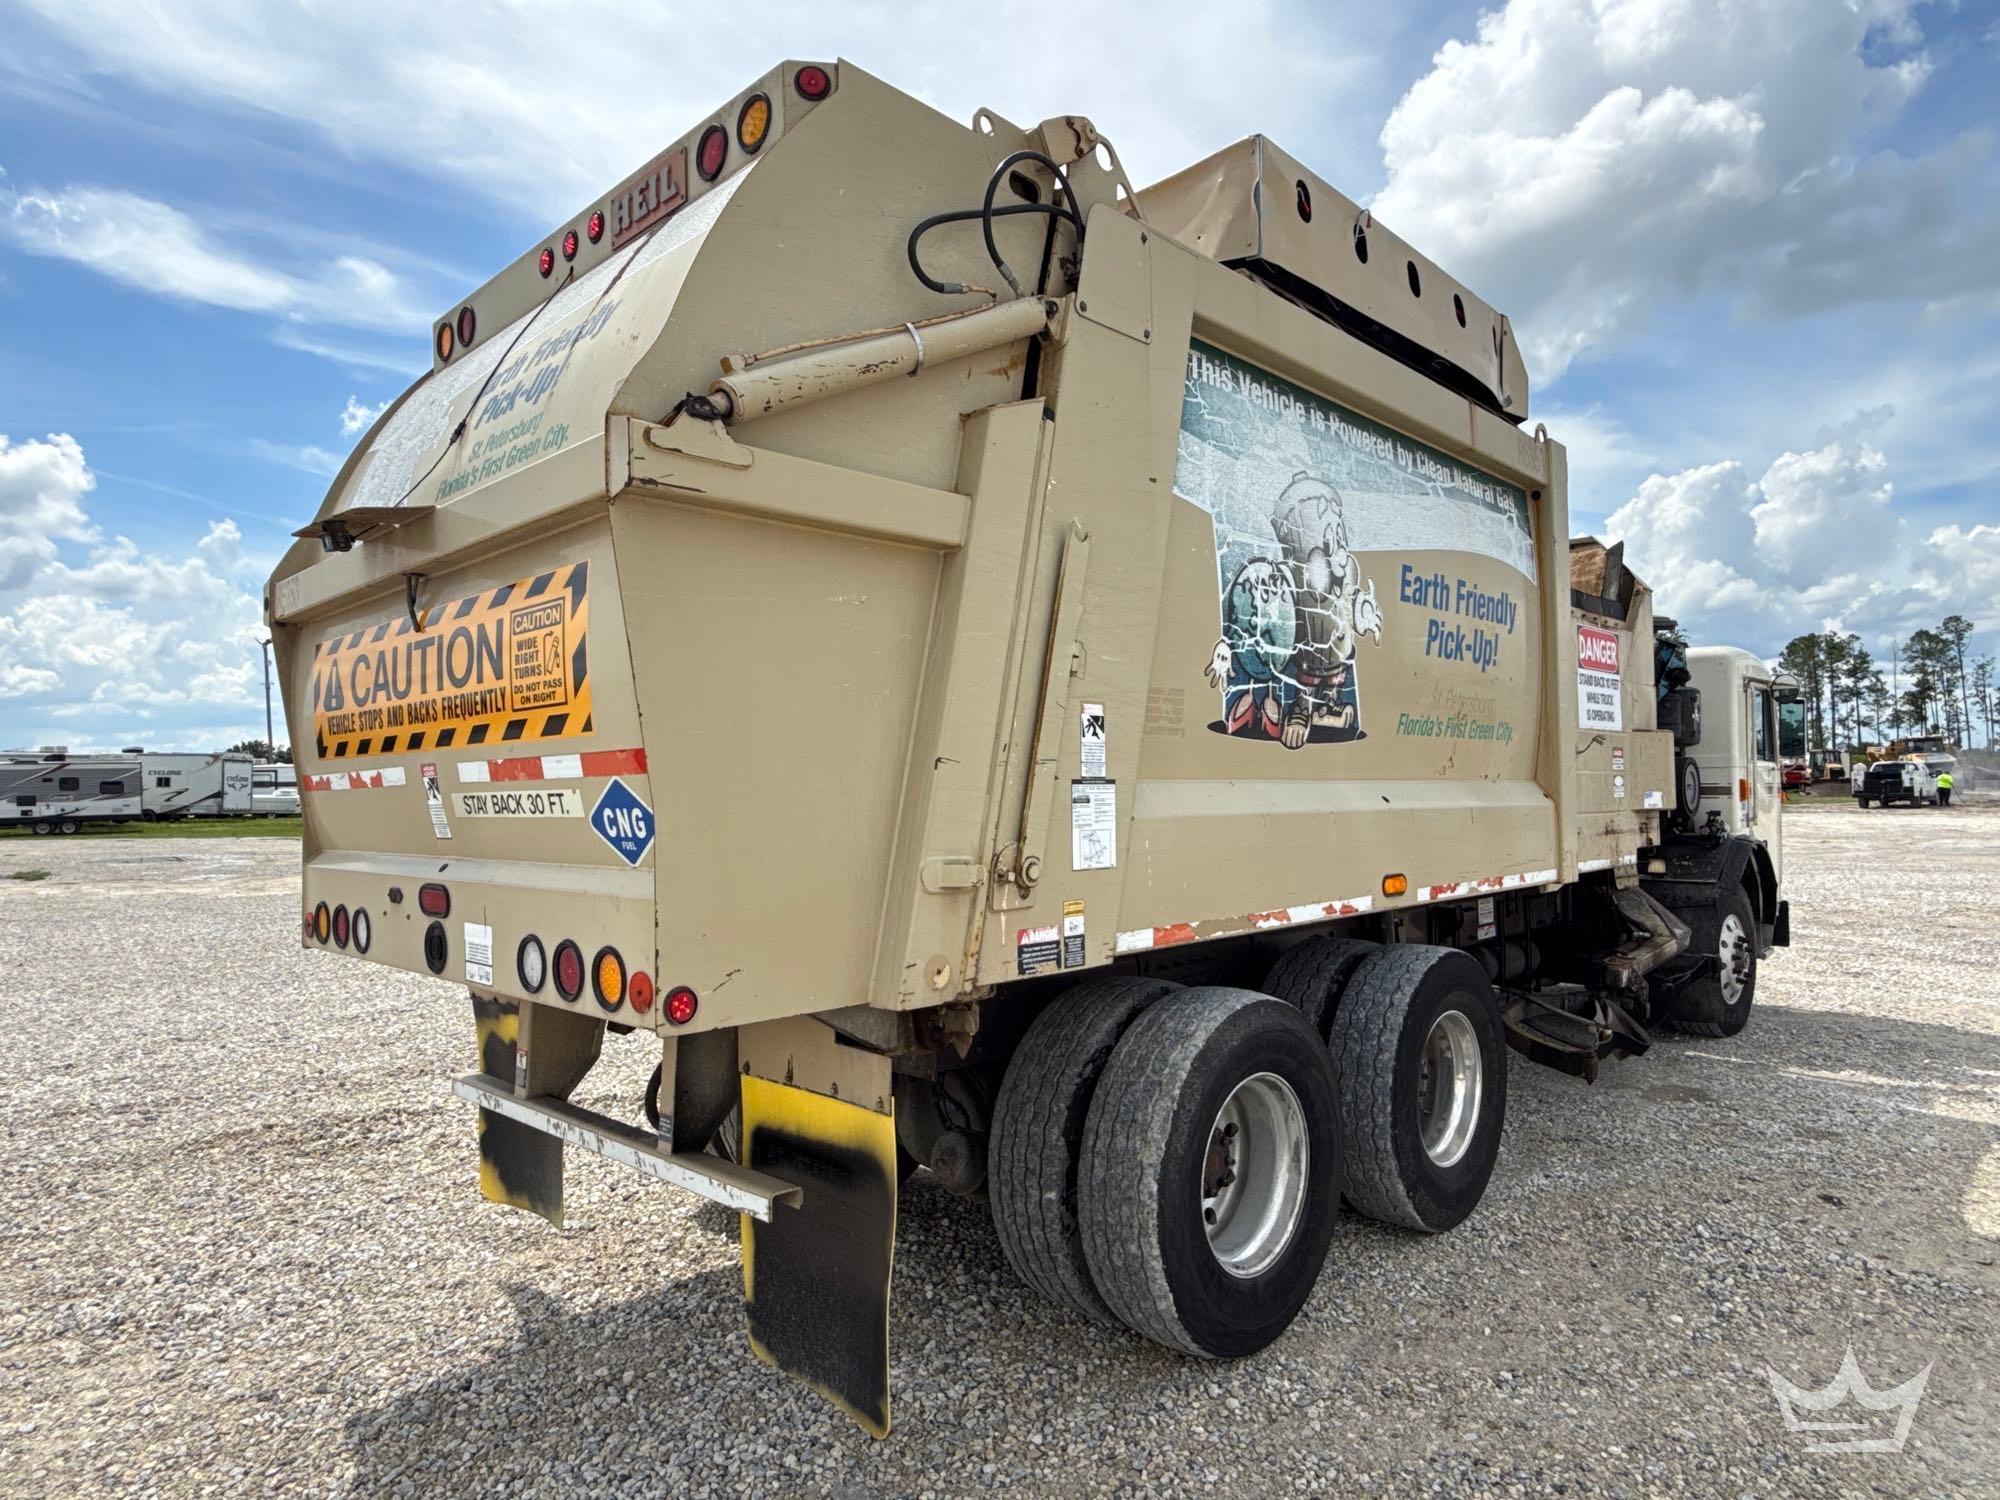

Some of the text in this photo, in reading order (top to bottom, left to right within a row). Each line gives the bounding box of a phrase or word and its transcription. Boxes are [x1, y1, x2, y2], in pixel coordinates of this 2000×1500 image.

[611, 163, 679, 237] HEIL
[482, 411, 544, 456] Petersburg
[1188, 350, 1233, 392] This
[1238, 369, 1305, 424] Vehicle
[1310, 406, 1325, 432] is
[1328, 411, 1393, 461] Powered
[1396, 440, 1413, 473] by
[1415, 449, 1452, 484] Clean
[1453, 465, 1495, 505] Natural
[435, 423, 570, 502] Florida's First Green City.
[1400, 563, 1517, 635] Earth Friendly
[514, 606, 561, 633] CAUTION
[515, 650, 540, 666] RIGHT
[516, 636, 538, 652] WIDE
[1425, 618, 1499, 673] Pick-Up!
[1579, 634, 1617, 667] DANGER
[351, 618, 504, 708] CAUTION
[514, 664, 542, 680] TURNS
[514, 678, 562, 694] DO NOT PASS
[1593, 675, 1605, 688] BACK
[327, 686, 506, 736] VEHICLE STOPS AND BACKS FREQUENTLY
[520, 691, 556, 705] ON RIGHT
[1600, 693, 1614, 706] TRUCK
[1396, 712, 1513, 746] Florida's First Green City.
[1591, 709, 1616, 722] OPERATING
[463, 792, 570, 815] STAY BACK 30 FT.
[603, 807, 647, 839] CNG
[621, 841, 637, 851] FUEL
